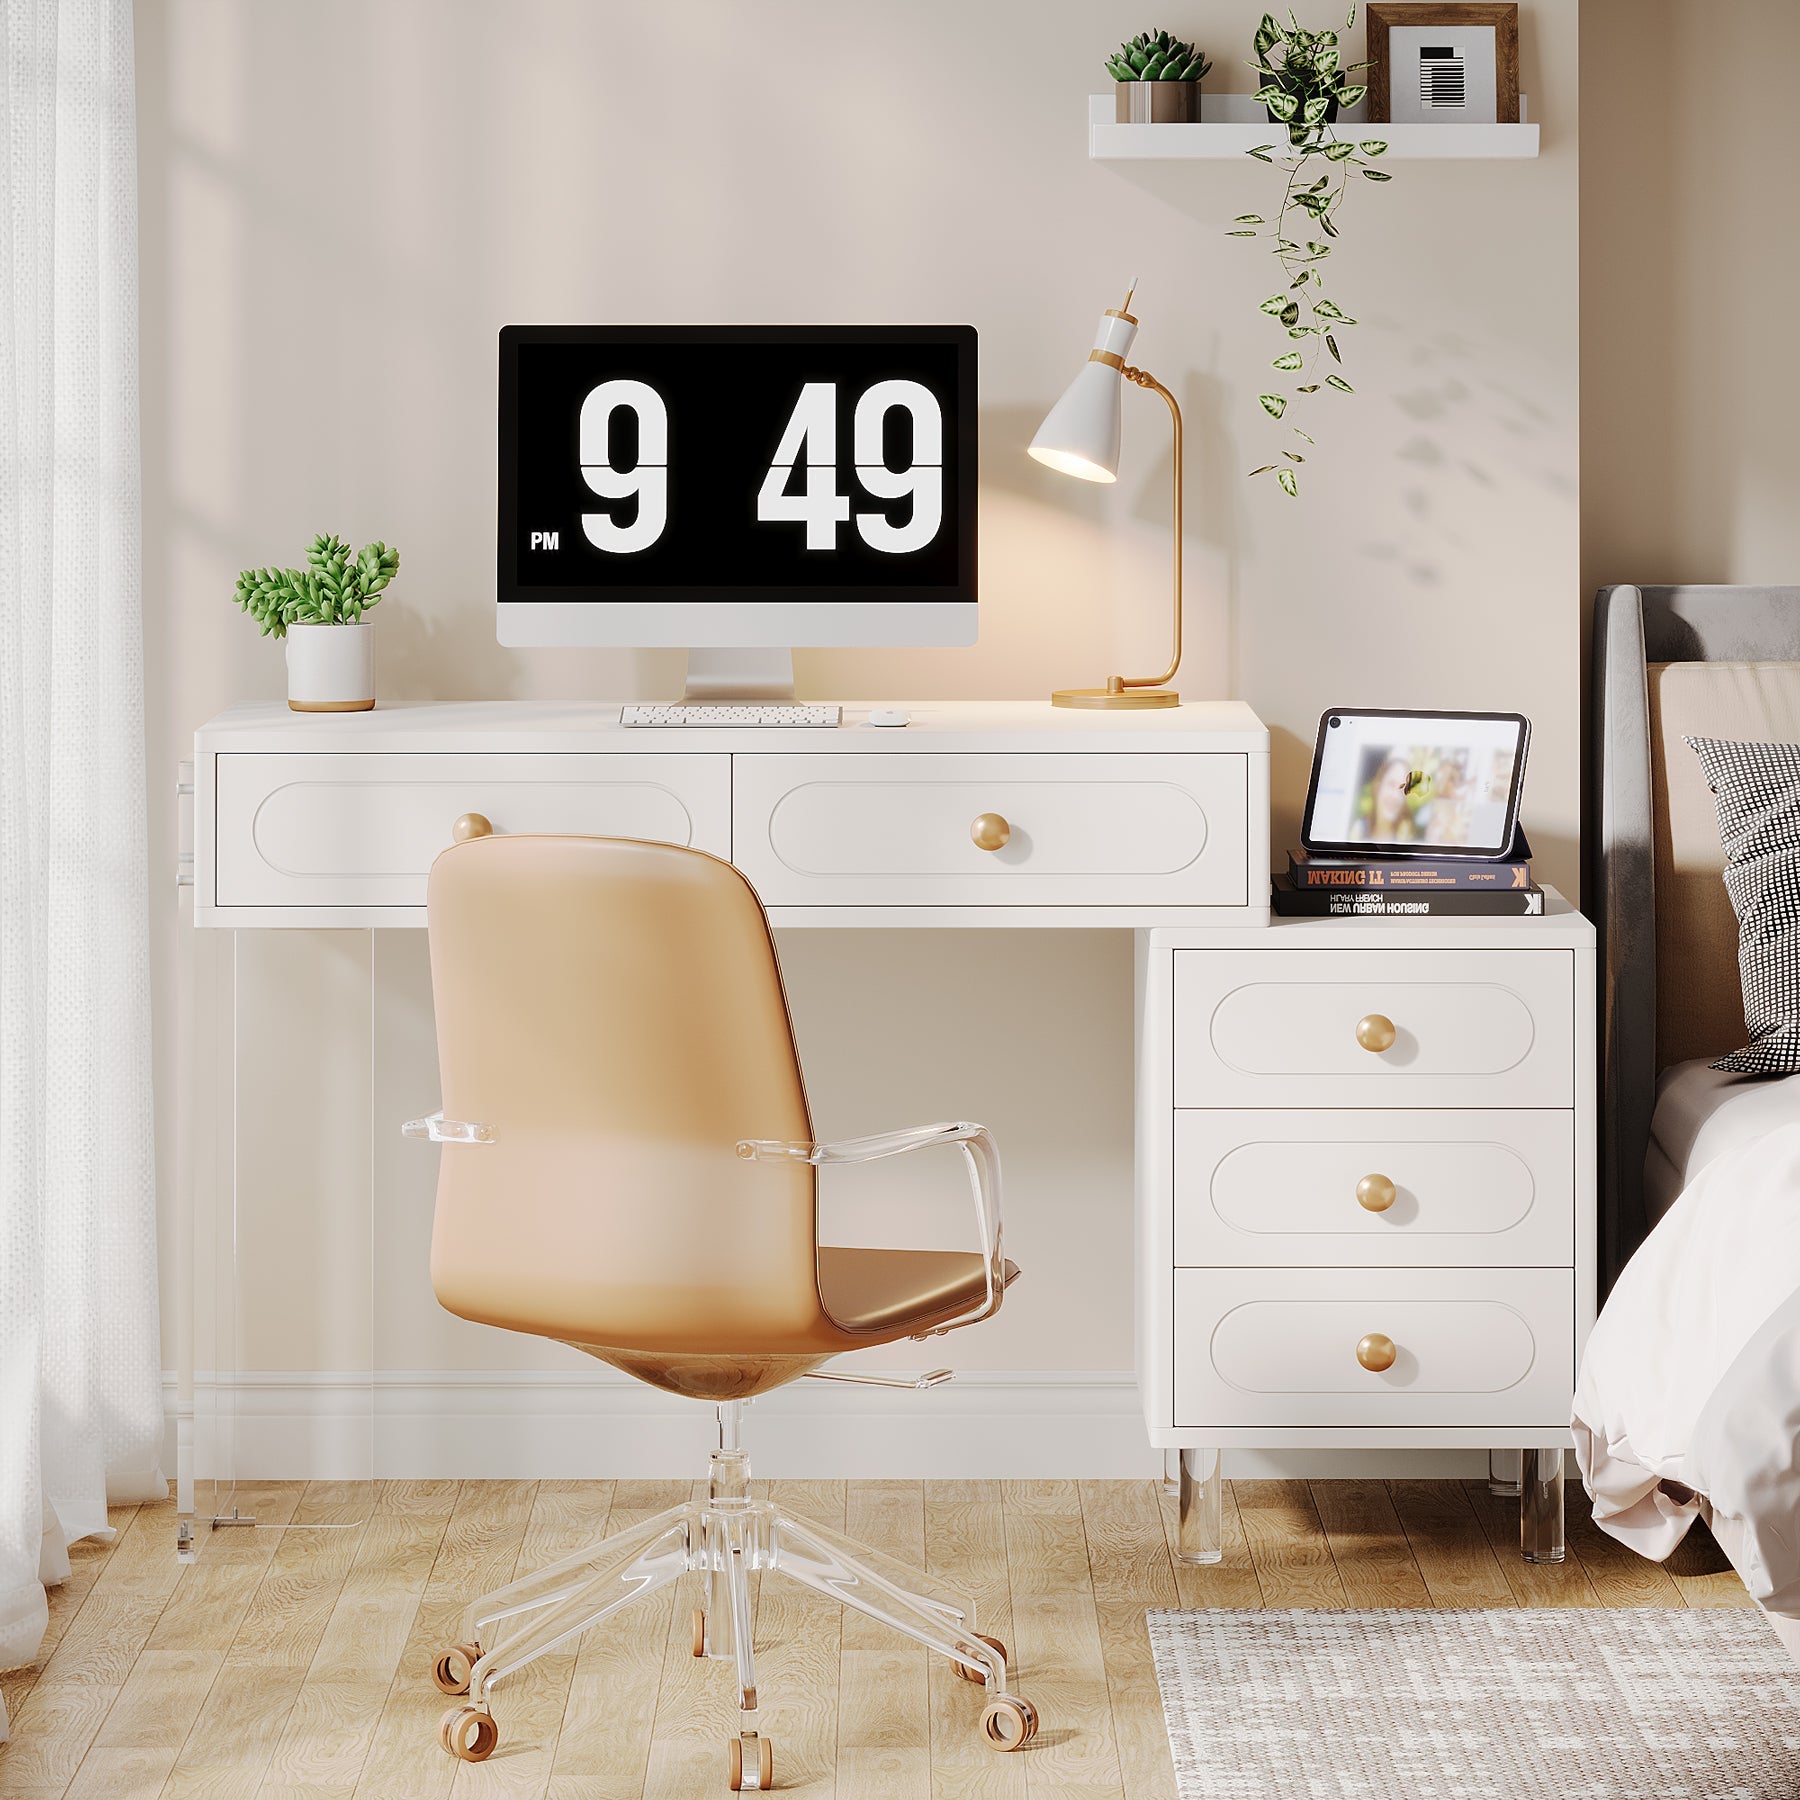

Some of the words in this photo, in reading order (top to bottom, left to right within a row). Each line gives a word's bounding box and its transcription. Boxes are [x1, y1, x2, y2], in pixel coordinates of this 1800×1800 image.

[580, 379, 667, 553] 9
[757, 379, 942, 553] 49
[531, 532, 559, 551] PM
